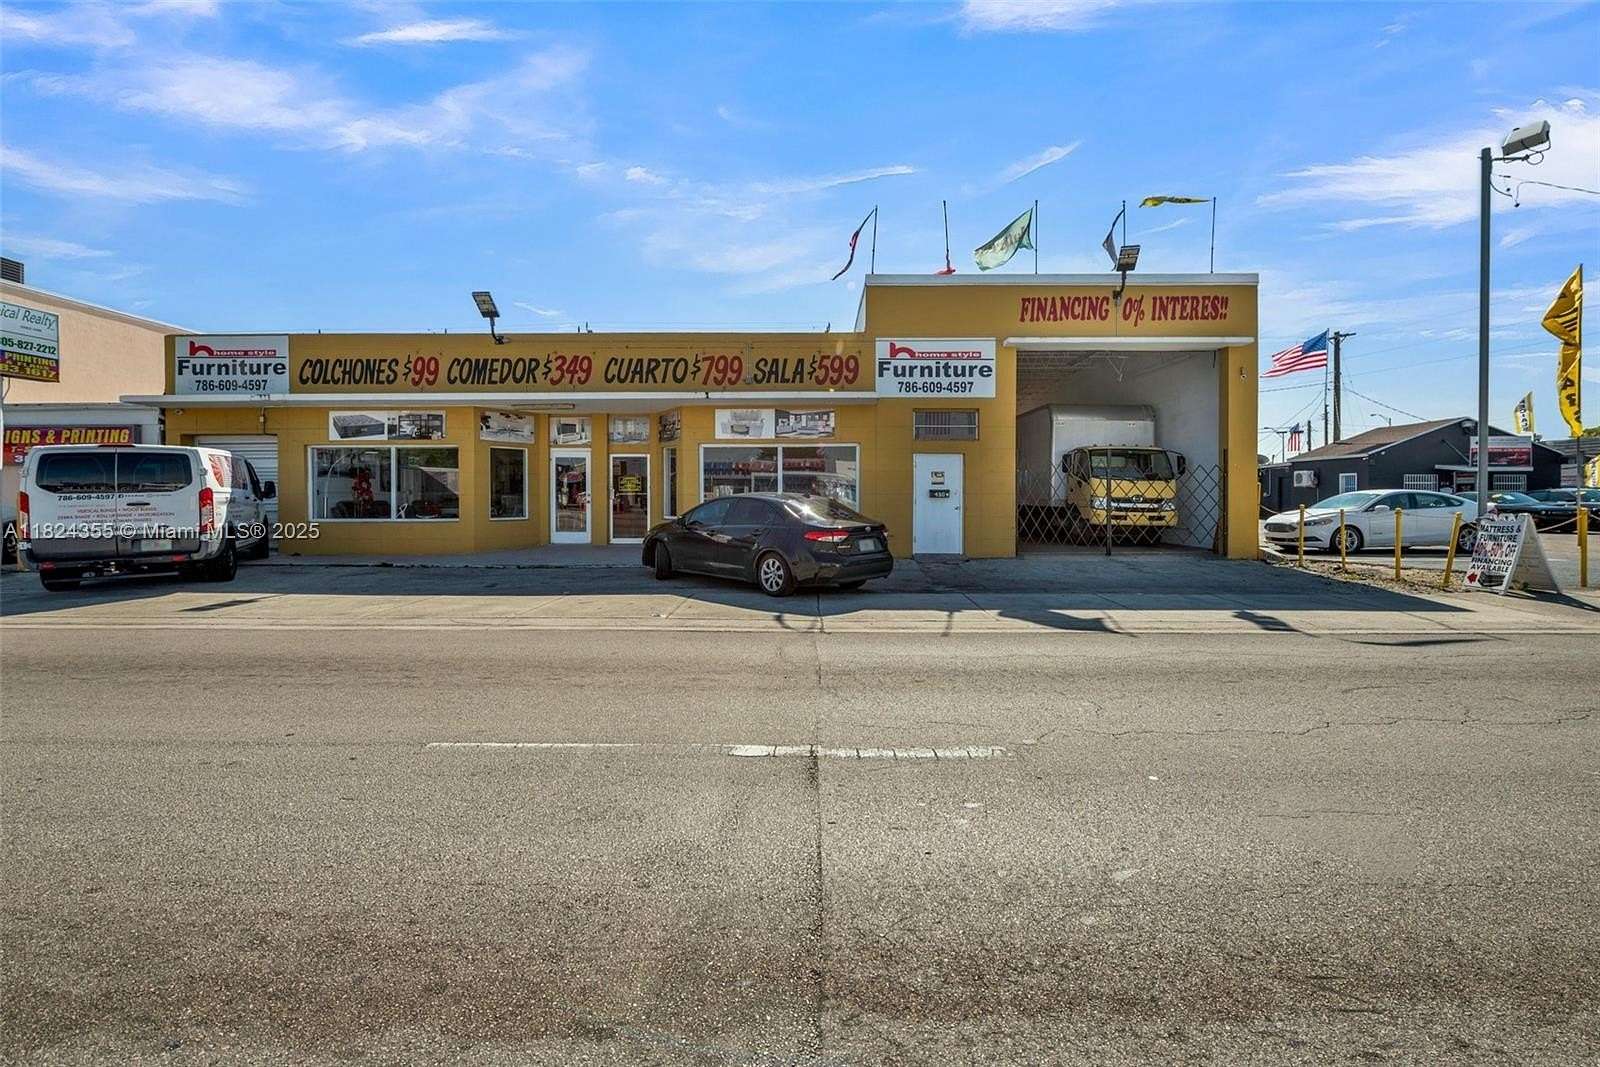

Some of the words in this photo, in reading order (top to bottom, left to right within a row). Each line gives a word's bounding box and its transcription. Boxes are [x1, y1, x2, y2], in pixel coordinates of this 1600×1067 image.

[22, 310, 55, 329] Realty
[1019, 296, 1109, 323] FINANCING
[1122, 296, 1145, 327] 0%
[1151, 296, 1229, 321] INTERES!!
[0, 337, 56, 354] 05-827-2212
[951, 351, 981, 359] style
[177, 359, 287, 376] Furniture
[299, 358, 399, 385] COLCHONES
[402, 354, 440, 386] $99
[447, 357, 540, 385] COMEDOR
[542, 353, 593, 386] $349
[604, 357, 689, 384] CUARTO
[690, 353, 743, 386] $799
[753, 358, 805, 384] SALA
[807, 354, 860, 386] $599
[878, 361, 993, 378] Furniture
[195, 380, 268, 391] 786-609-4597
[898, 381, 974, 393] 786-609-4597
[46, 429, 56, 444] &
[61, 429, 130, 444] PRINTING
[1471, 564, 1509, 572] AVAILABLE
[1472, 557, 1512, 566] FINANCING
